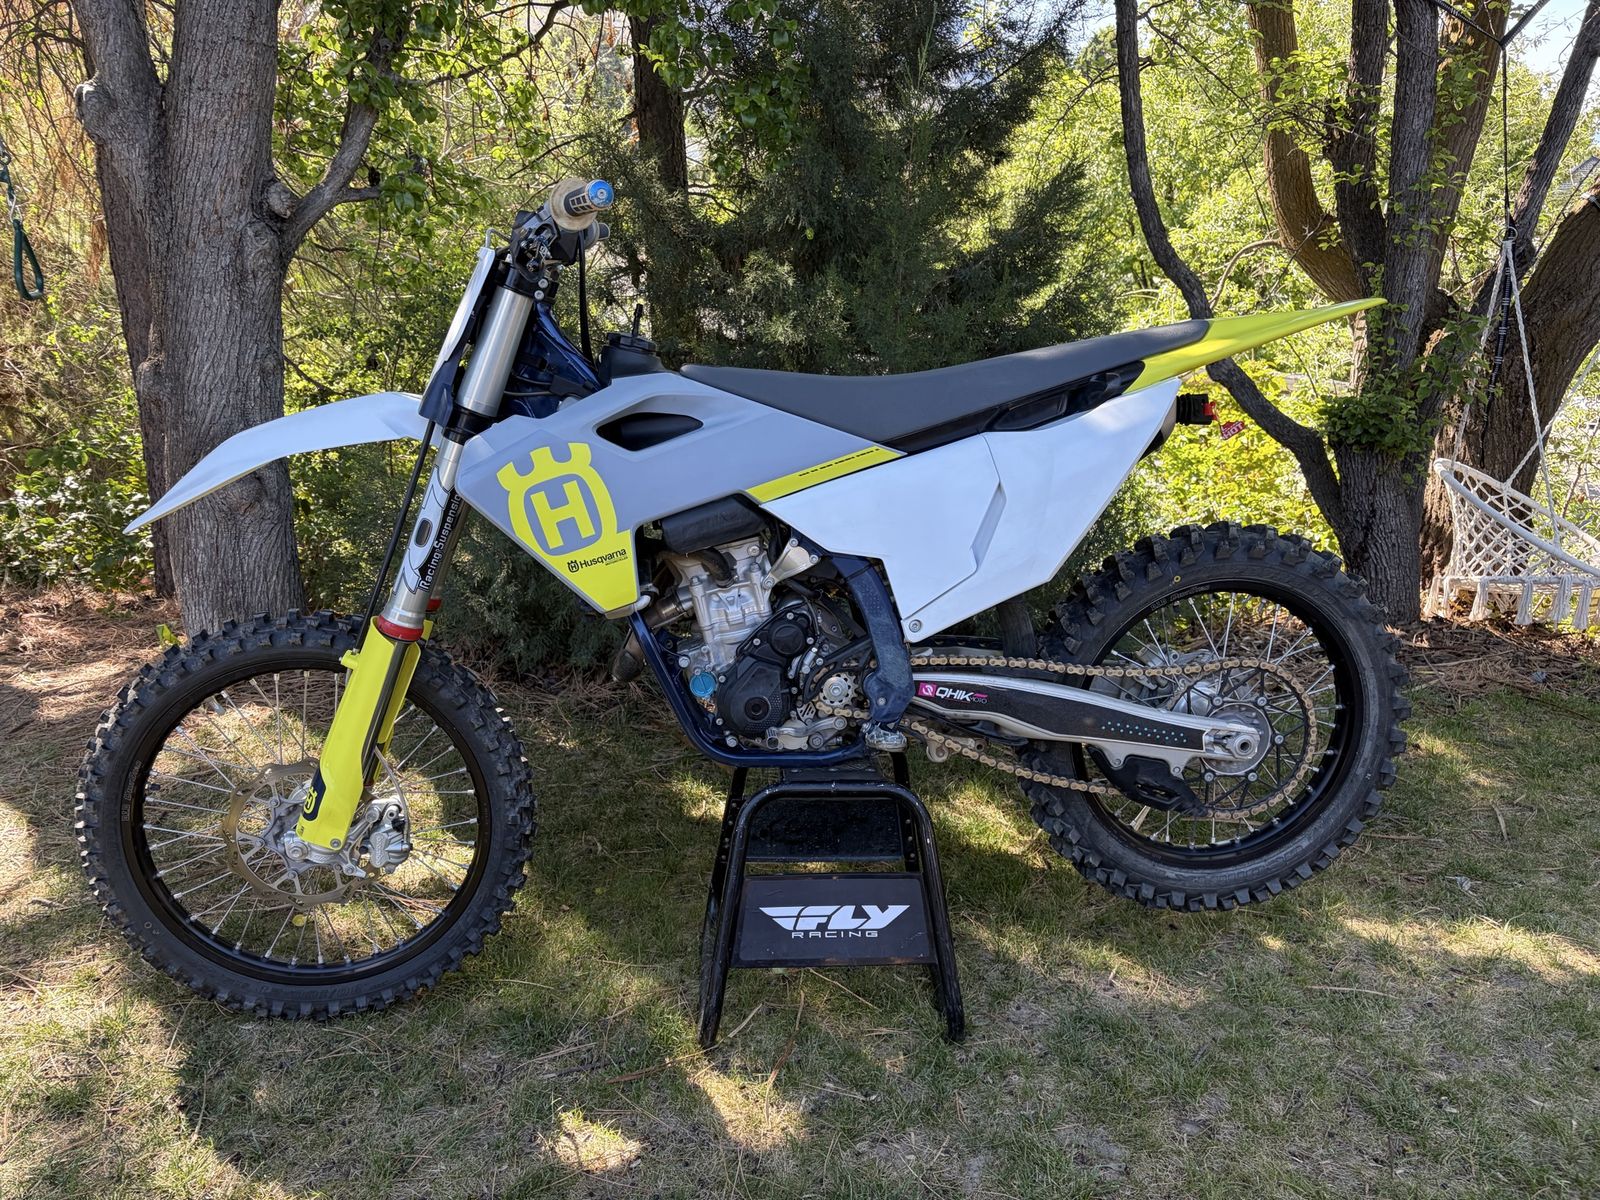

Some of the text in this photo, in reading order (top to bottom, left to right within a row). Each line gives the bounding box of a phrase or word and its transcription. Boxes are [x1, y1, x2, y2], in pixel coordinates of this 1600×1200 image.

[530, 480, 596, 550] H
[420, 494, 462, 592] Racing Suspensio
[580, 548, 627, 569] Husqvarna
[935, 687, 974, 702] QHIK
[759, 904, 911, 930] FLY
[792, 930, 879, 939] RACING
